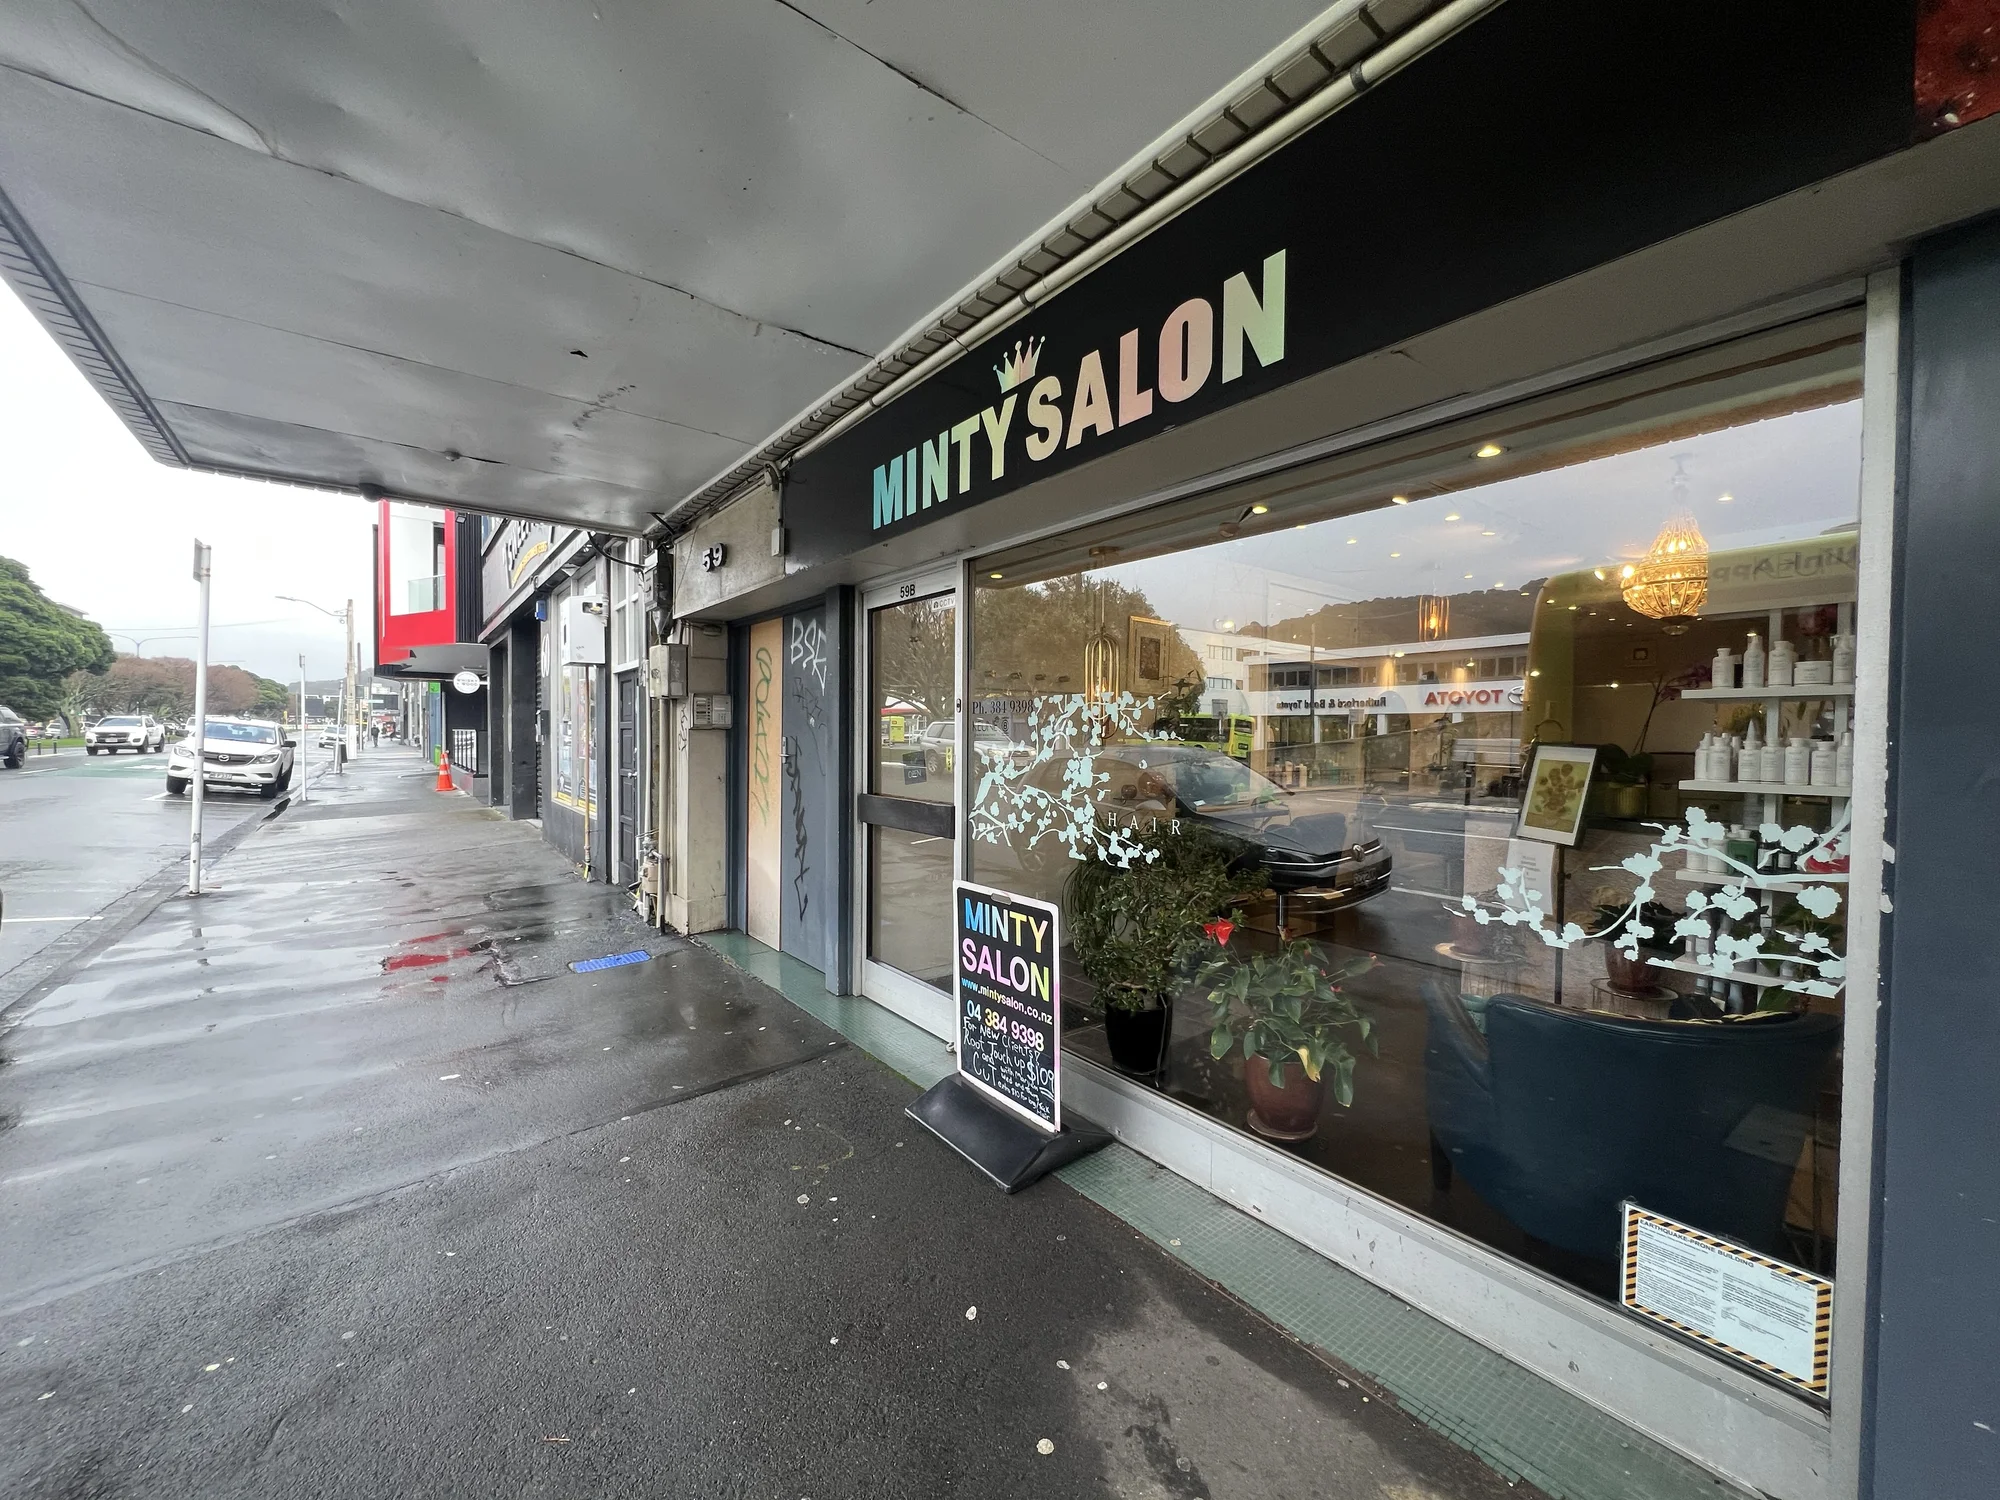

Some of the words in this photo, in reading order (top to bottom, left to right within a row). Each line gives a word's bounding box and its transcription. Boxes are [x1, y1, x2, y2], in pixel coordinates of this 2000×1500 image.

[873, 393, 1018, 530] MINTY
[1025, 248, 1287, 462] SALON
[702, 543, 726, 572] 59
[900, 584, 915, 598] 59B
[940, 598, 954, 607] CCTV
[972, 701, 987, 715] Ph.
[990, 701, 1006, 714] 384
[1009, 699, 1034, 713] 9398
[964, 897, 1048, 953] MINTY
[962, 938, 1050, 1002] SALON
[961, 977, 1053, 1025] www.mintysalon.co.nz
[963, 1016, 977, 1031] For
[967, 999, 981, 1022] 04
[984, 1007, 1008, 1035] 384
[1011, 1020, 1045, 1052] 9398
[963, 1027, 985, 1052] Root
[987, 1040, 1013, 1067] Touch
[1014, 1056, 1025, 1075] up
[1027, 1057, 1055, 1093] $109
[981, 1052, 995, 1065] and
[1717, 1249, 1755, 1268] BUILDING
